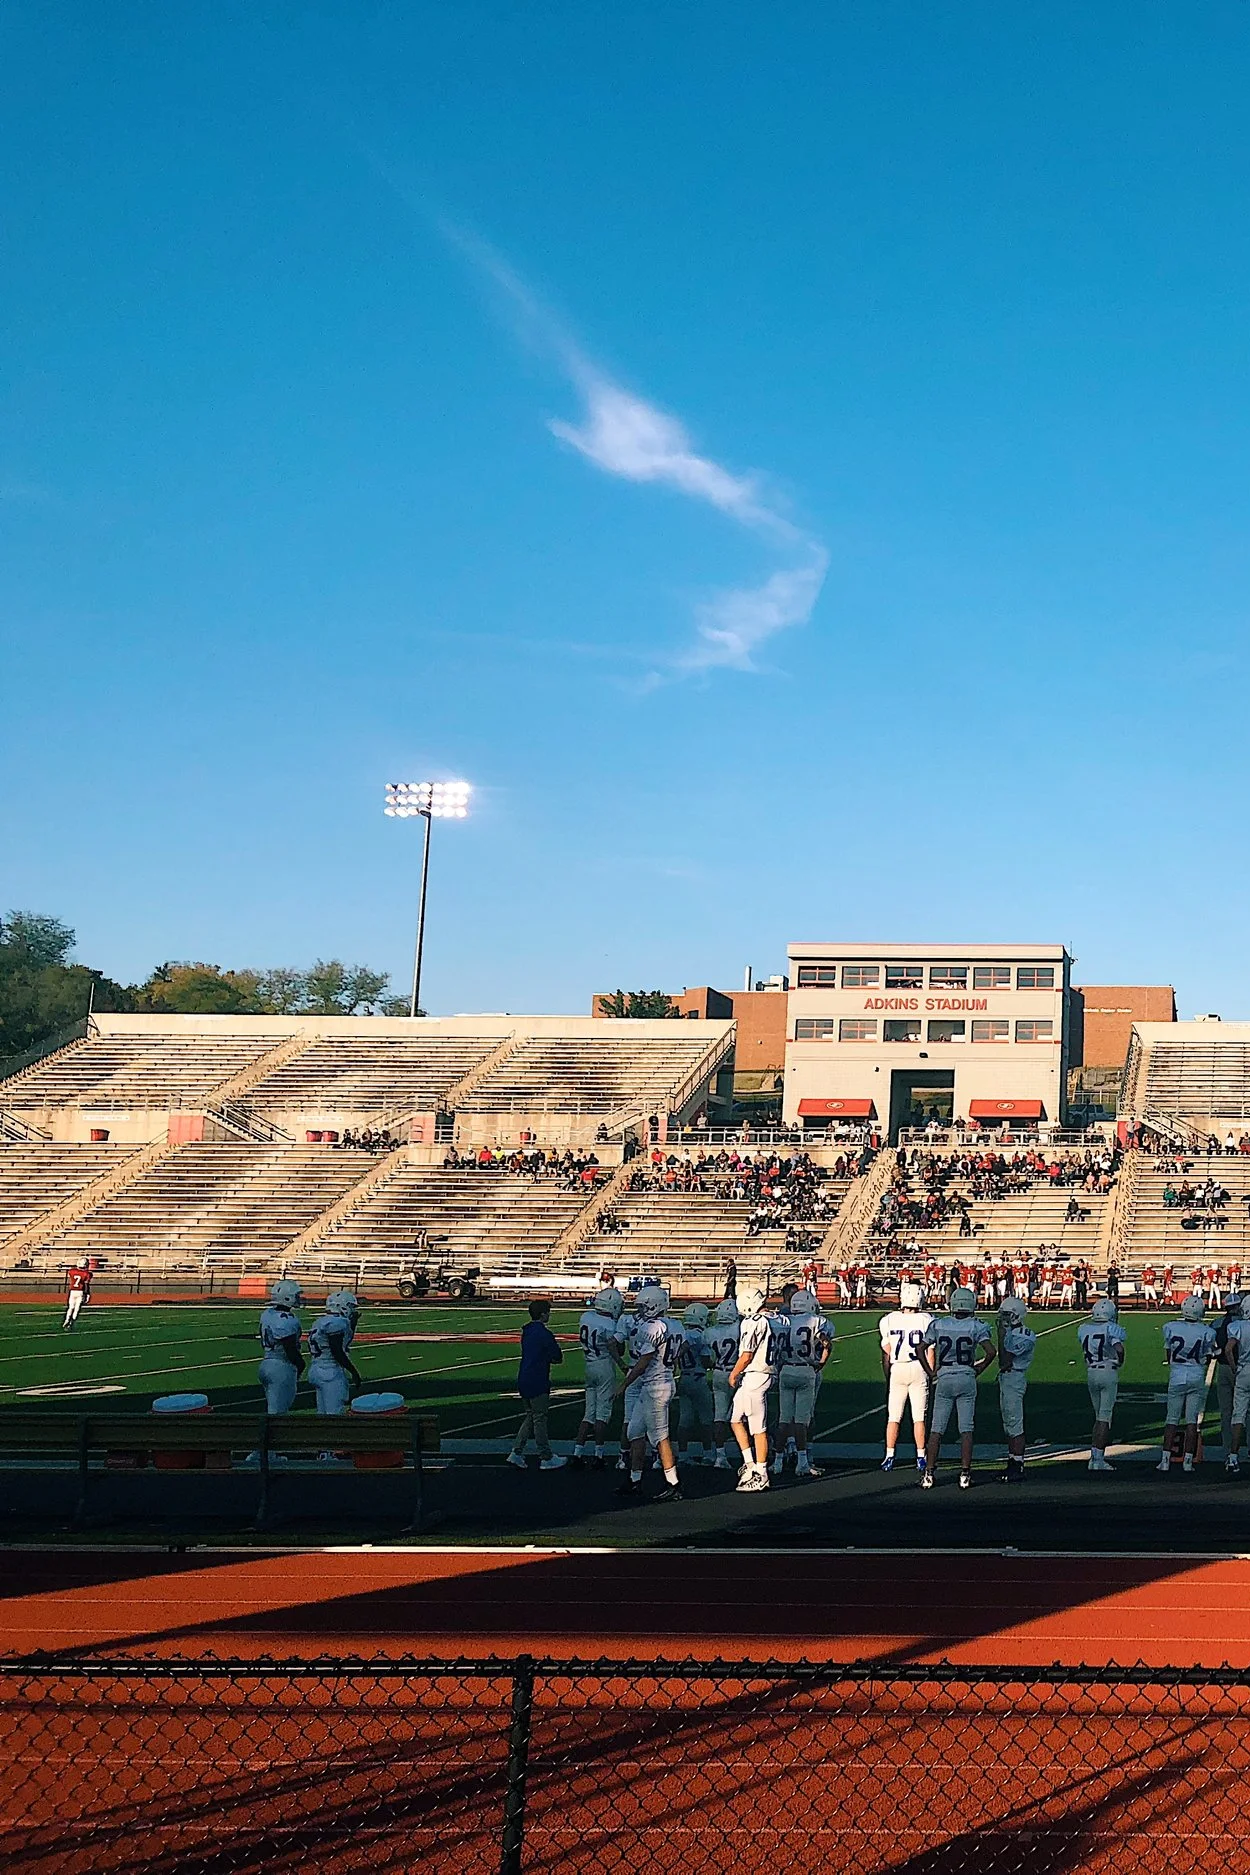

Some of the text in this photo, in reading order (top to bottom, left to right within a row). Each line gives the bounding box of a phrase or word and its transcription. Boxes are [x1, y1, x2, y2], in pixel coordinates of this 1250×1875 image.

[864, 998, 988, 1010] ADKINS STADIUM
[73, 1275, 81, 1288] 7
[890, 1330, 923, 1360] 79
[938, 1336, 973, 1366] 26
[1171, 1335, 1203, 1364] 24
